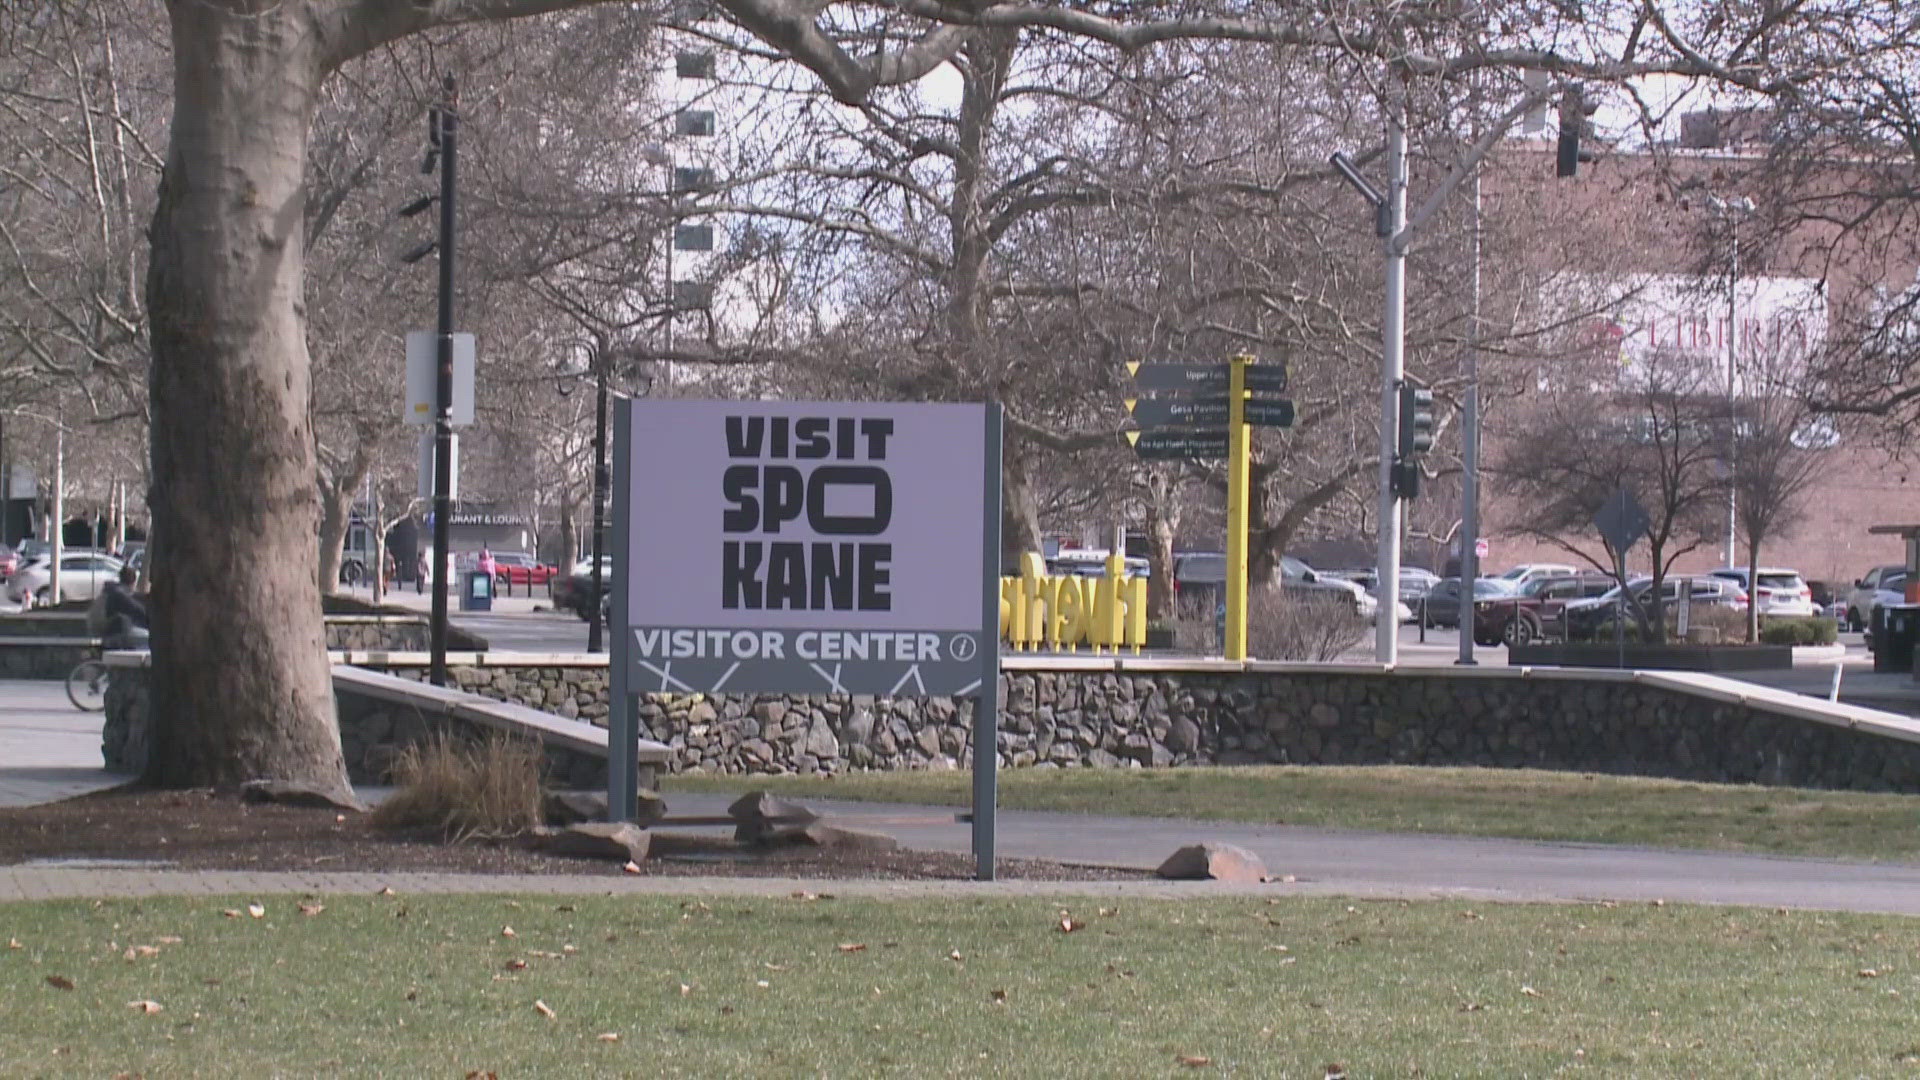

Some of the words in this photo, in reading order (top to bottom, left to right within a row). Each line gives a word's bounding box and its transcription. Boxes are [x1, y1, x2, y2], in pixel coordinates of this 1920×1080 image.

[1186, 371, 1208, 381] Upper
[725, 416, 894, 461] VISIT
[723, 465, 892, 535] SPO
[722, 541, 891, 611] KANE
[634, 629, 785, 659] VISITOR
[795, 631, 940, 661] CENTER
